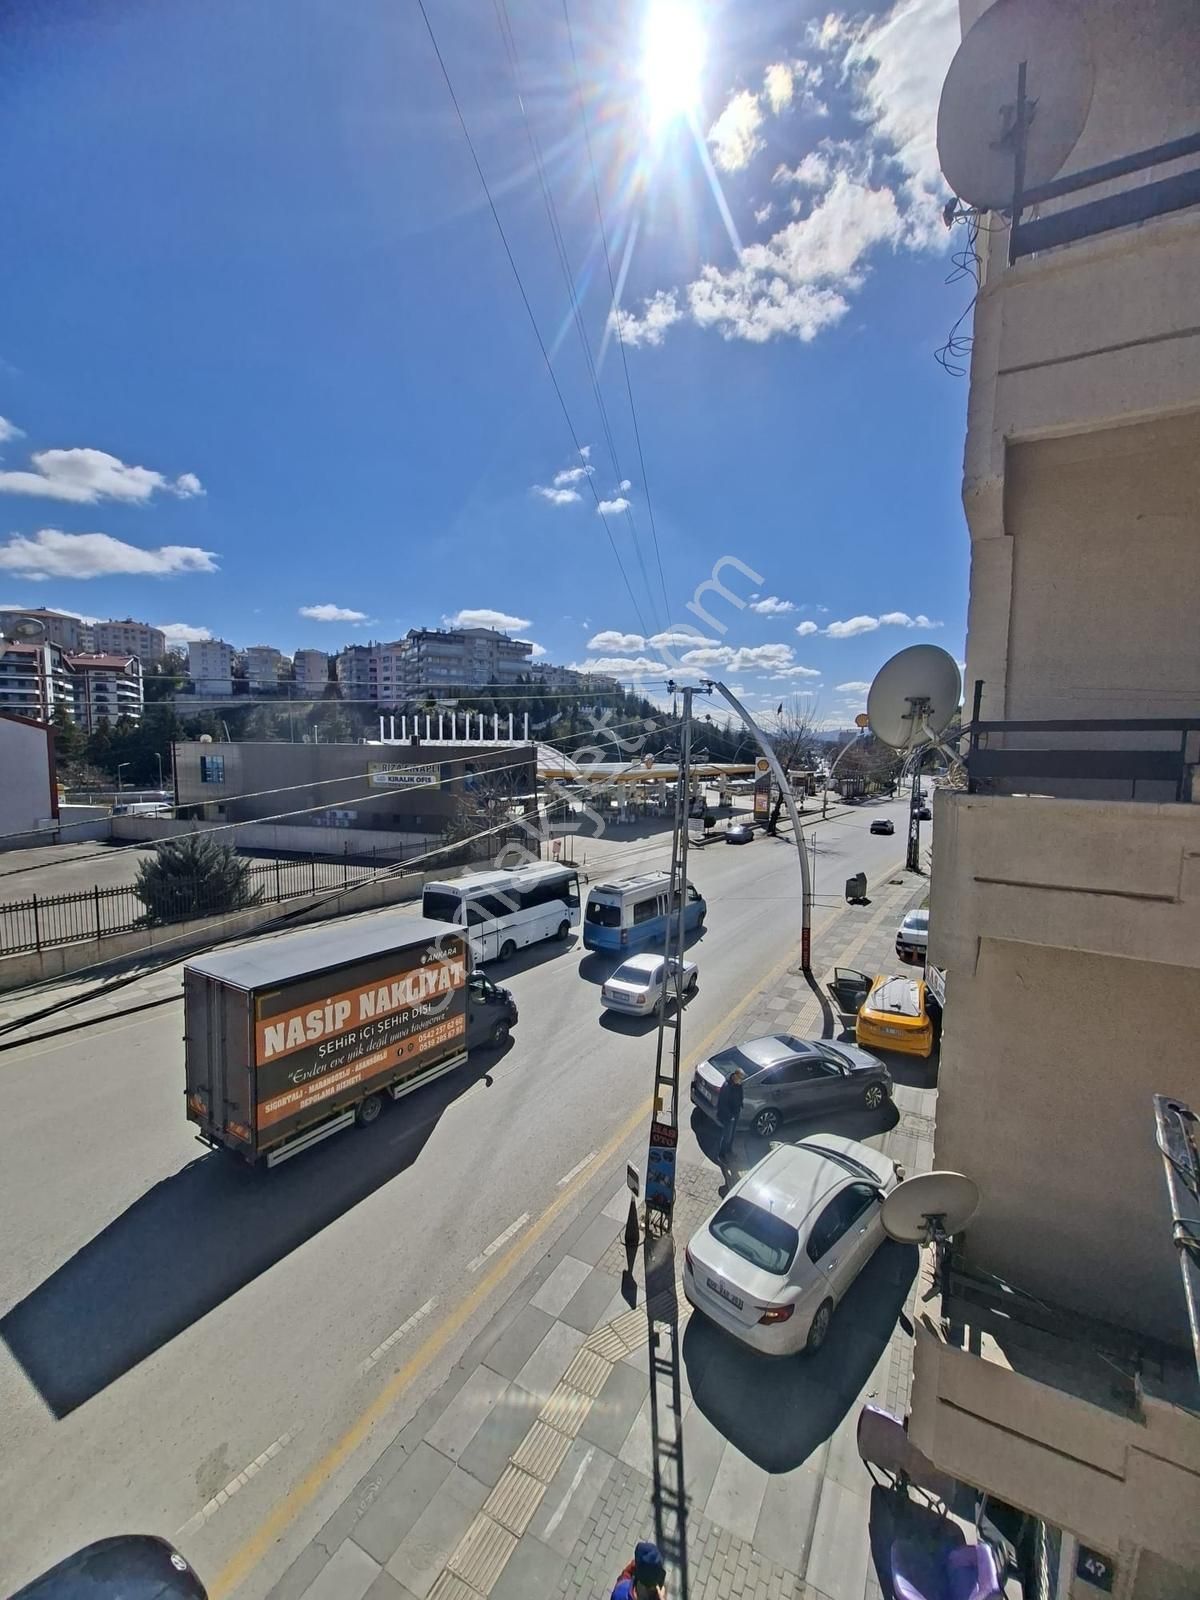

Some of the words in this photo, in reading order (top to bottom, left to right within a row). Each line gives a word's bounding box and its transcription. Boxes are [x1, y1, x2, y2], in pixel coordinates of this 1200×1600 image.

[427, 947, 457, 962] ANKARA
[264, 998, 351, 1057] NASİP
[359, 961, 464, 1020] NAKLİYAT
[330, 1055, 345, 1068] eve
